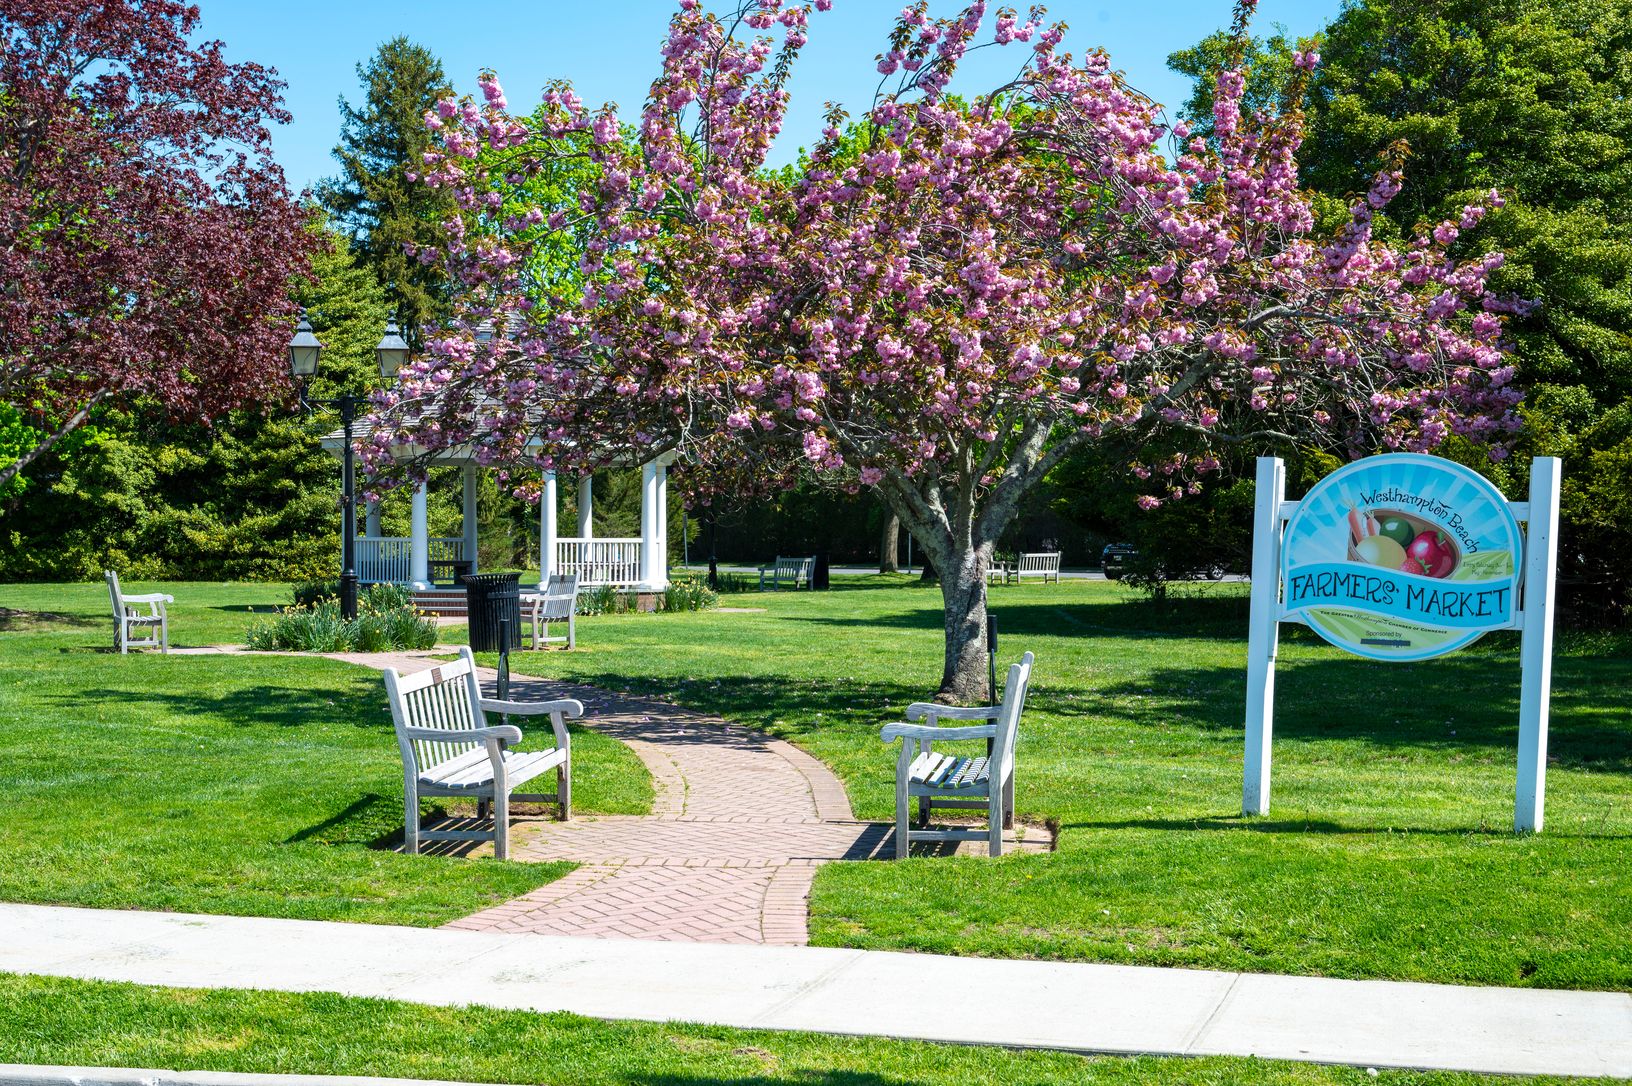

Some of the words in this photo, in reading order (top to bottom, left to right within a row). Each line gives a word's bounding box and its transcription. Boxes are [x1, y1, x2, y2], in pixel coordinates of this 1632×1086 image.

[1360, 487, 1449, 519] Westhampton
[1447, 512, 1480, 554] Beach
[1406, 584, 1510, 617] MARKET
